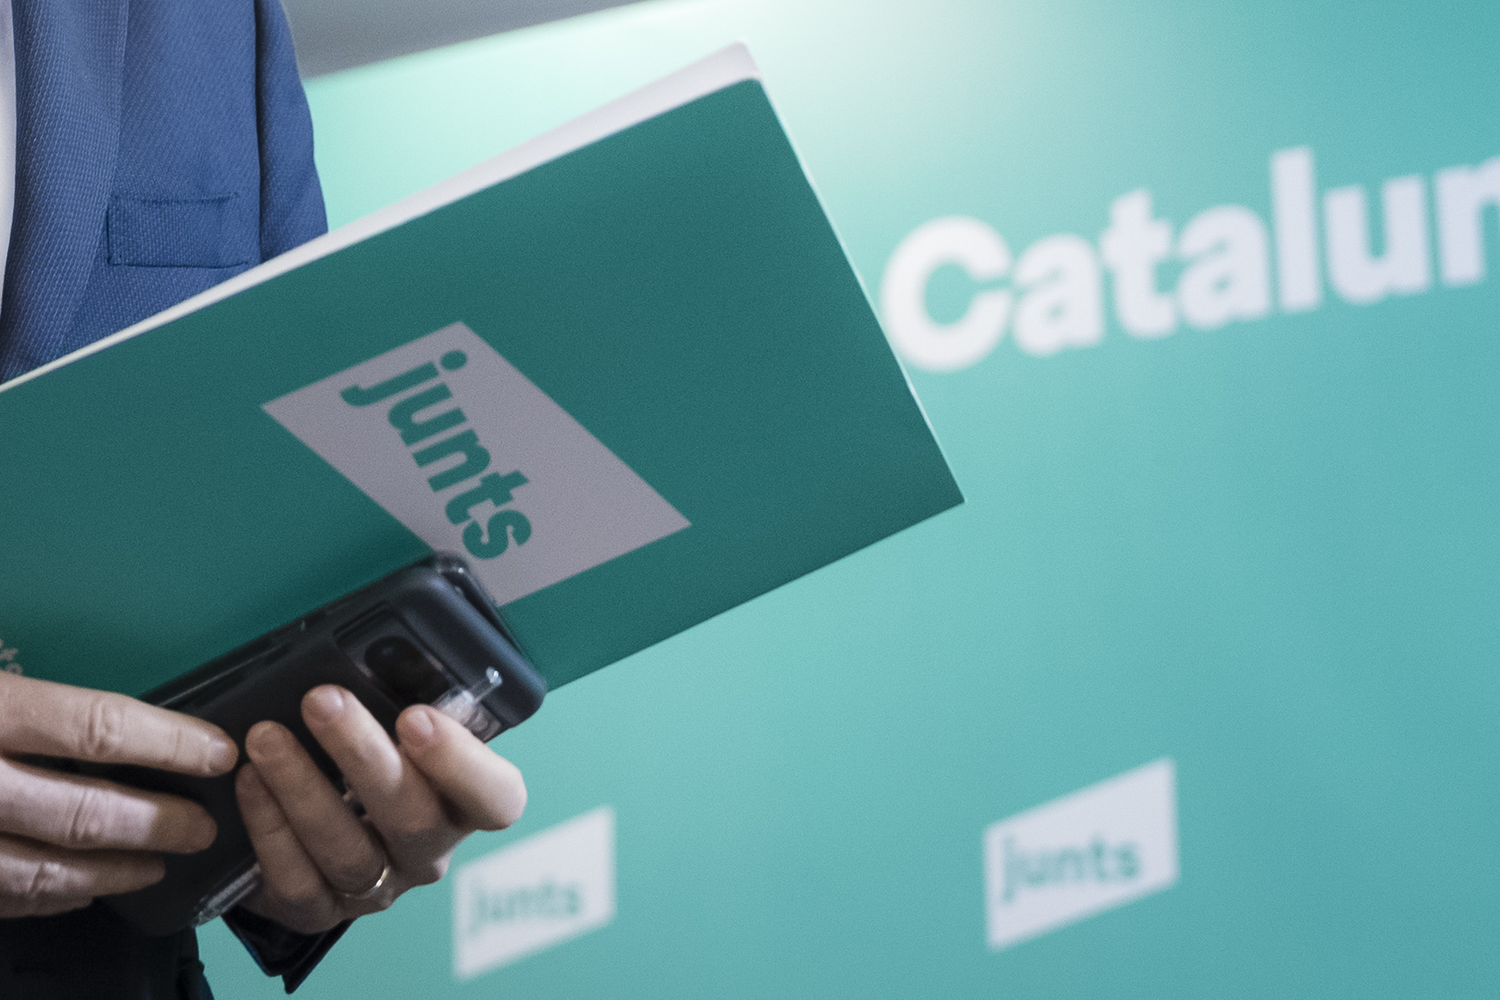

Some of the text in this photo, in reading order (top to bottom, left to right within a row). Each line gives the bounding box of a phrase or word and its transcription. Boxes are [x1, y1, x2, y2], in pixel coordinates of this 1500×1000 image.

[340, 349, 532, 560] junts
[1002, 834, 1141, 903] junts
[469, 874, 582, 937] junts
